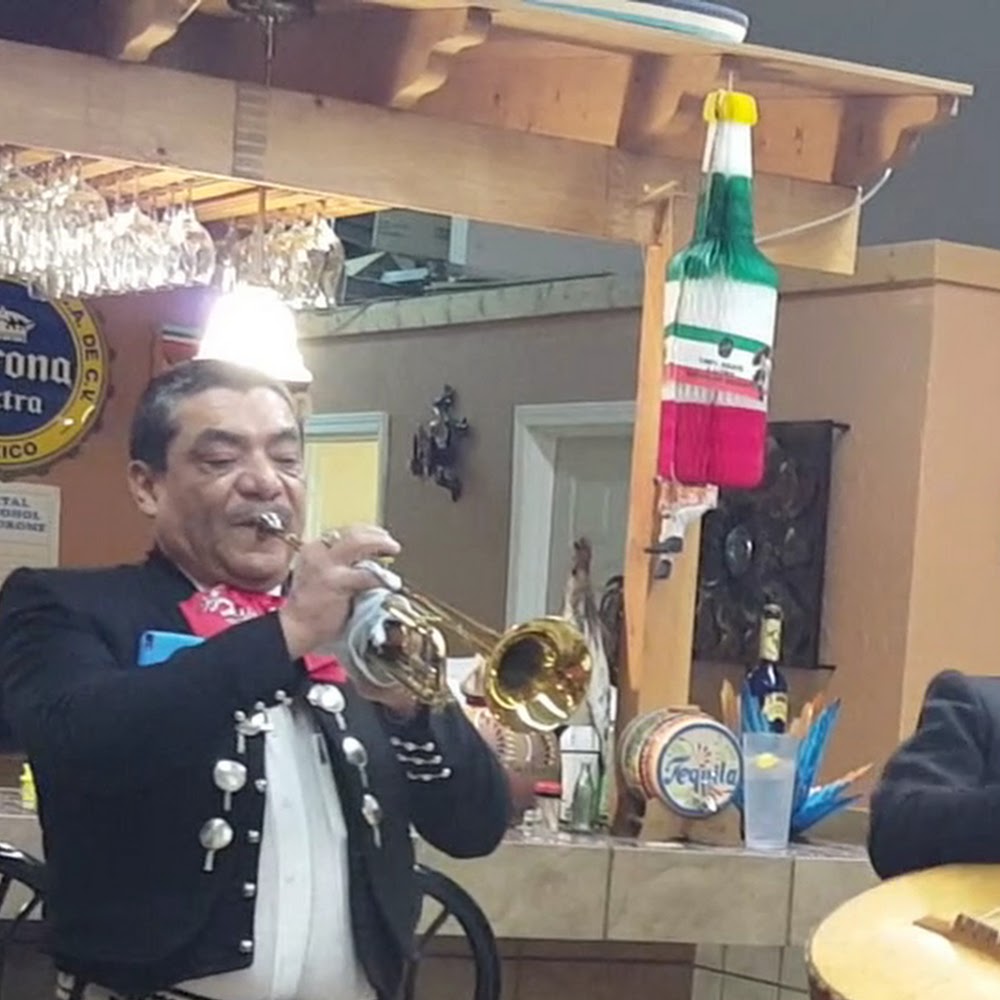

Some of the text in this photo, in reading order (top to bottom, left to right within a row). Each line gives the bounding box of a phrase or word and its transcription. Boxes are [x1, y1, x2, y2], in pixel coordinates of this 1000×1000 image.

[82, 333, 99, 362] DE
[0, 349, 71, 388] ona
[0, 390, 42, 414] tra
[2, 441, 38, 460] ICO
[664, 757, 738, 796] Tequila
